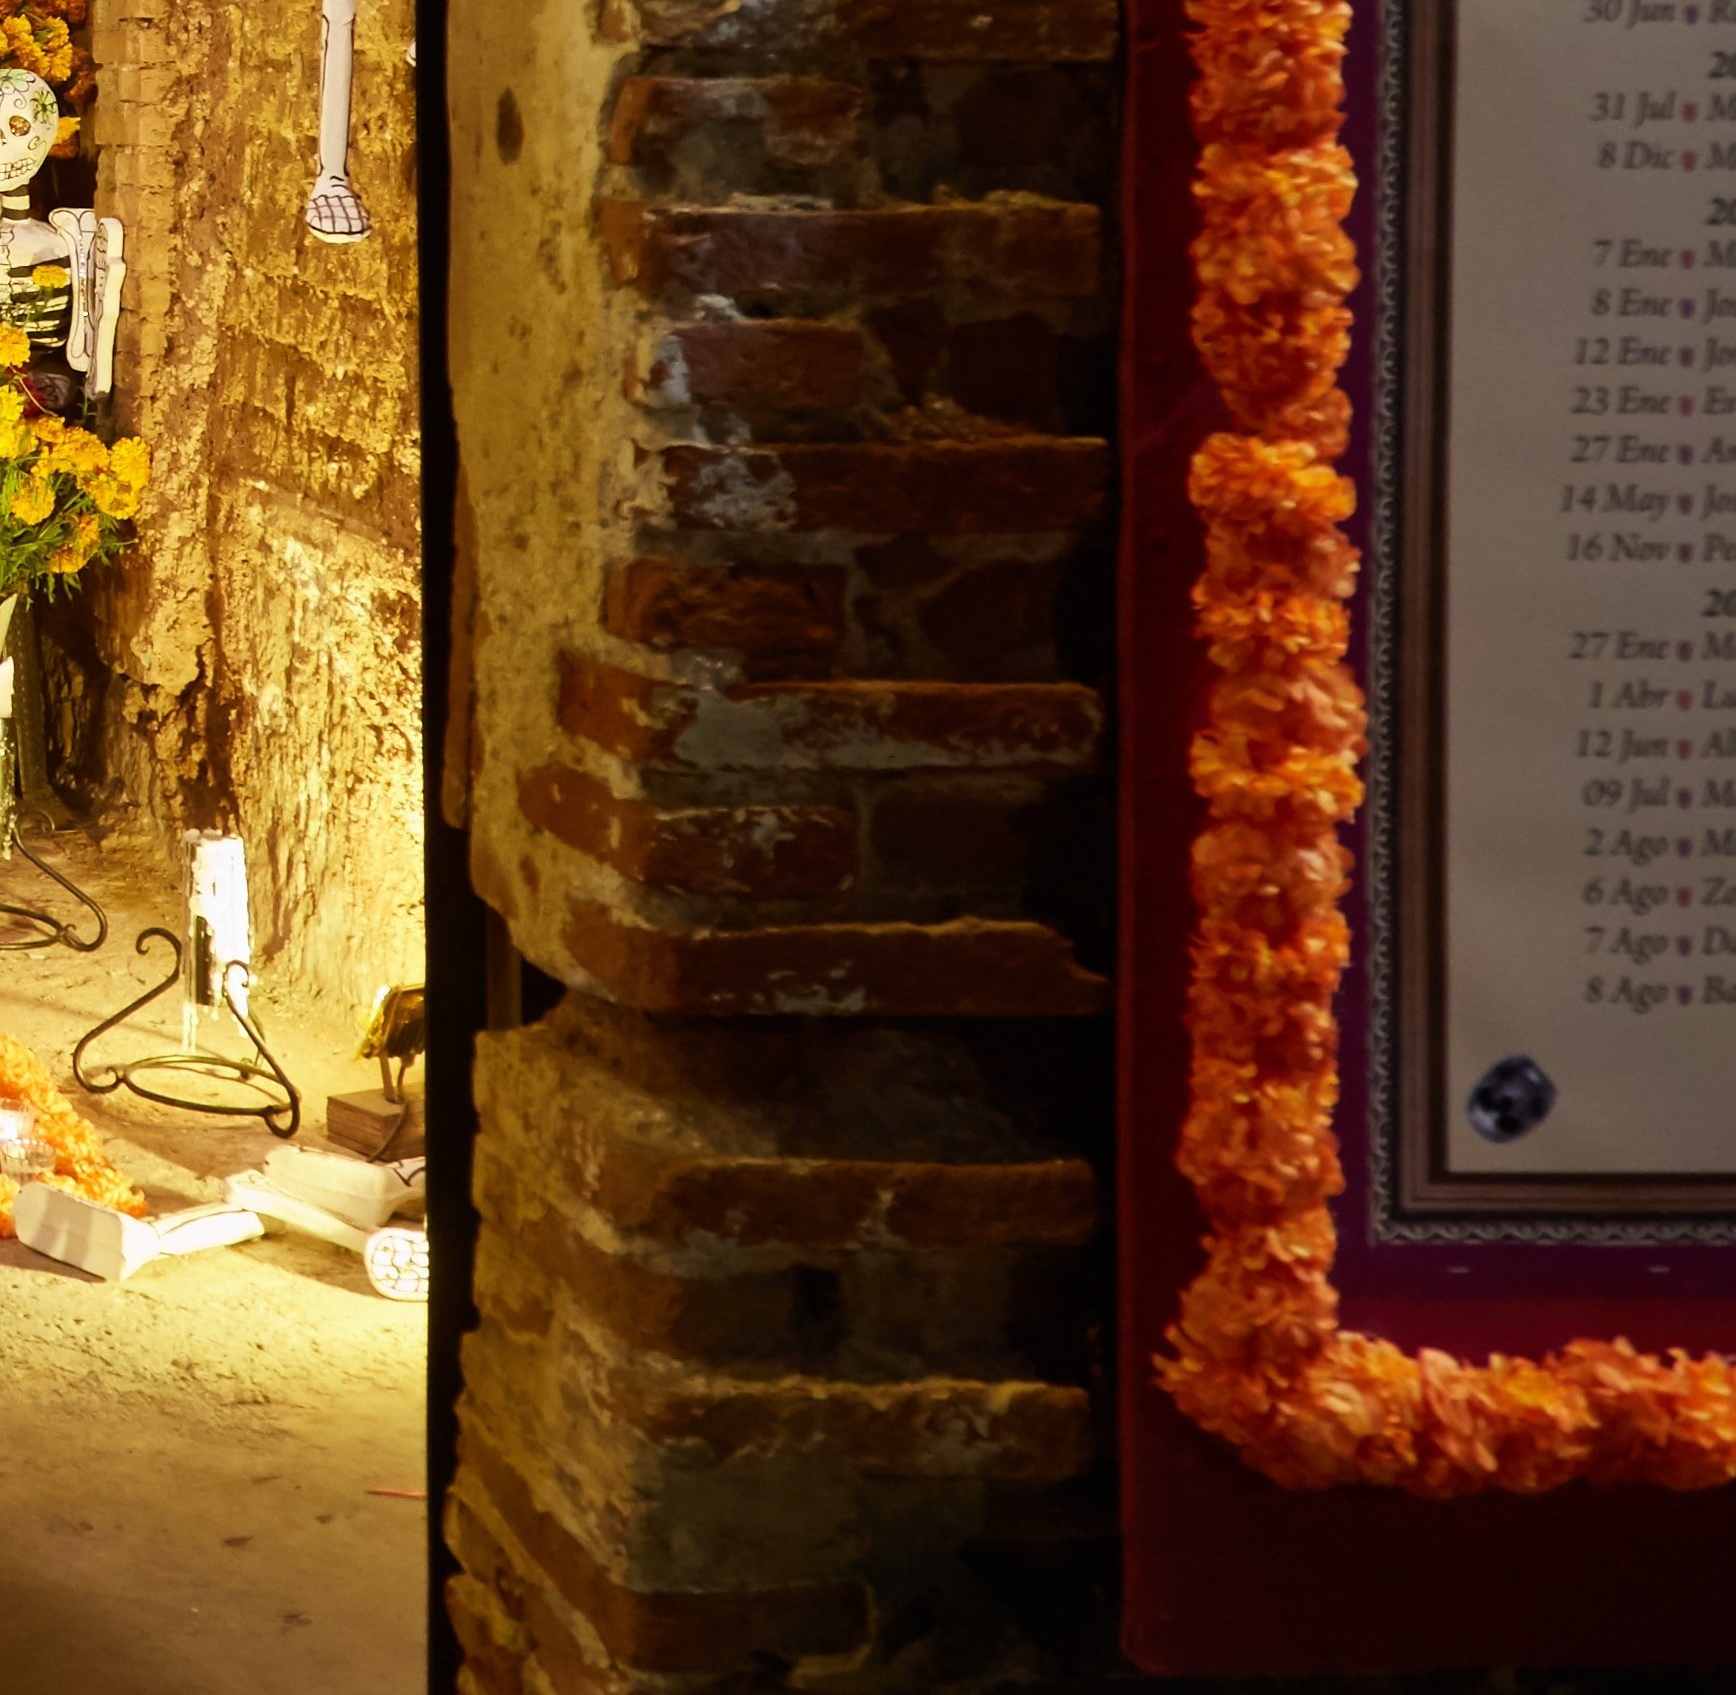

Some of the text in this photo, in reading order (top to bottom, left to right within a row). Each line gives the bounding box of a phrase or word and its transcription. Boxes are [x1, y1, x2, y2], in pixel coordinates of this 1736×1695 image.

[1589, 90, 1676, 128] 31 Jul
[1596, 139, 1674, 170] 8 Dic
[1592, 238, 1613, 268] 7
[1590, 287, 1611, 318] 8
[1573, 335, 1610, 366] 12
[1570, 384, 1610, 416] 23
[1569, 433, 1610, 465] 27
[1561, 482, 1670, 522] 14 May
[1566, 532, 1603, 563] 16
[1568, 629, 1610, 661] 27
[1589, 678, 1669, 710] 1 Abr
[1577, 728, 1669, 764] 12 Jun
[1581, 776, 1670, 814] 09 Jul
[1583, 827, 1669, 867] 2 Ago
[1582, 876, 1669, 916] 6 Ago
[1584, 925, 1669, 966] 7 Ago
[1584, 975, 1669, 1015] 8 Ago
